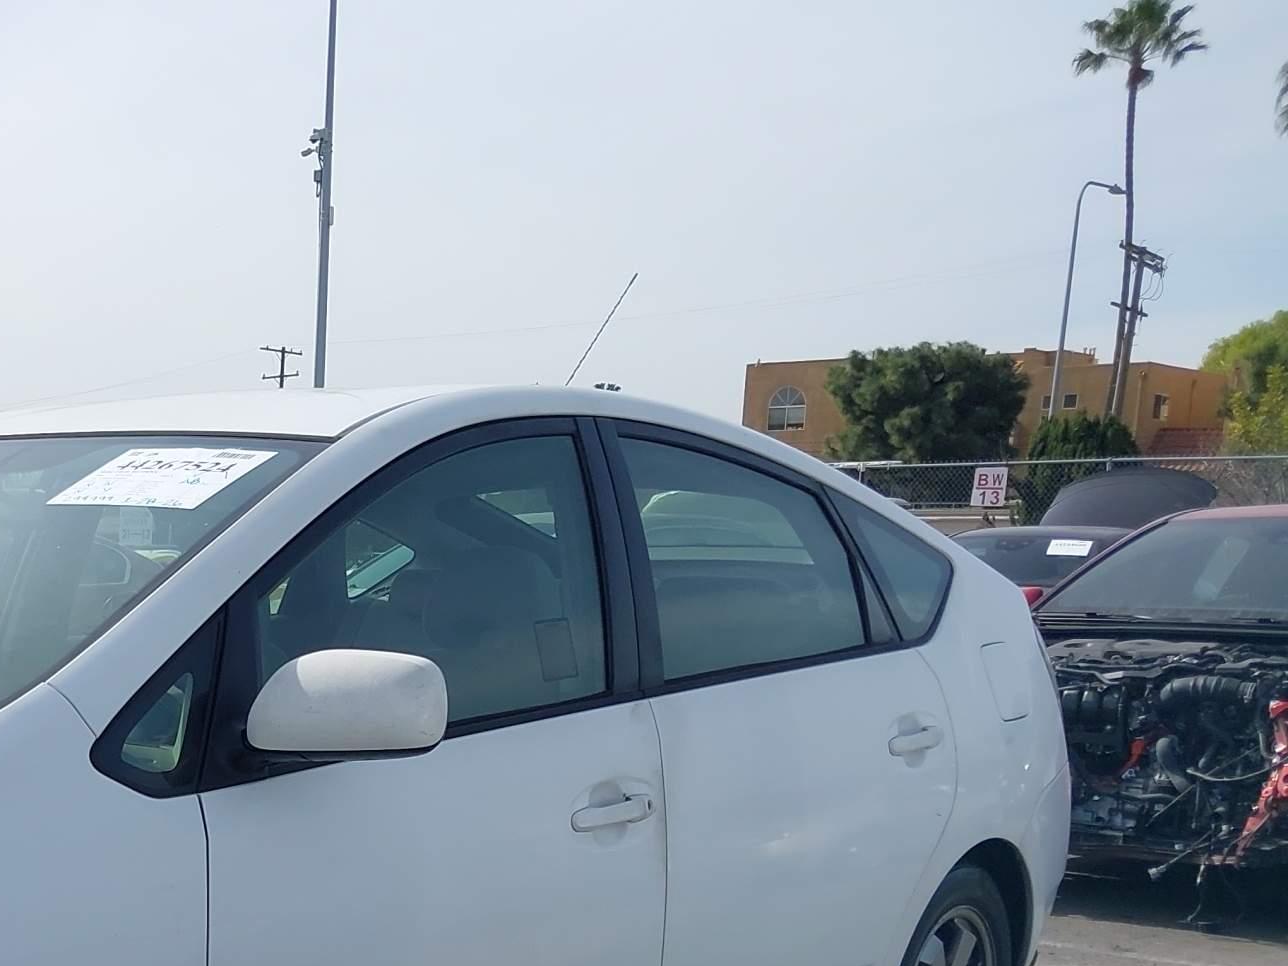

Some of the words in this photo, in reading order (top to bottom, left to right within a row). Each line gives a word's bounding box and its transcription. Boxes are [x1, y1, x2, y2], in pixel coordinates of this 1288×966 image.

[117, 460, 237, 472] 44267524
[978, 474, 1004, 486] BW
[979, 491, 1000, 505] 13
